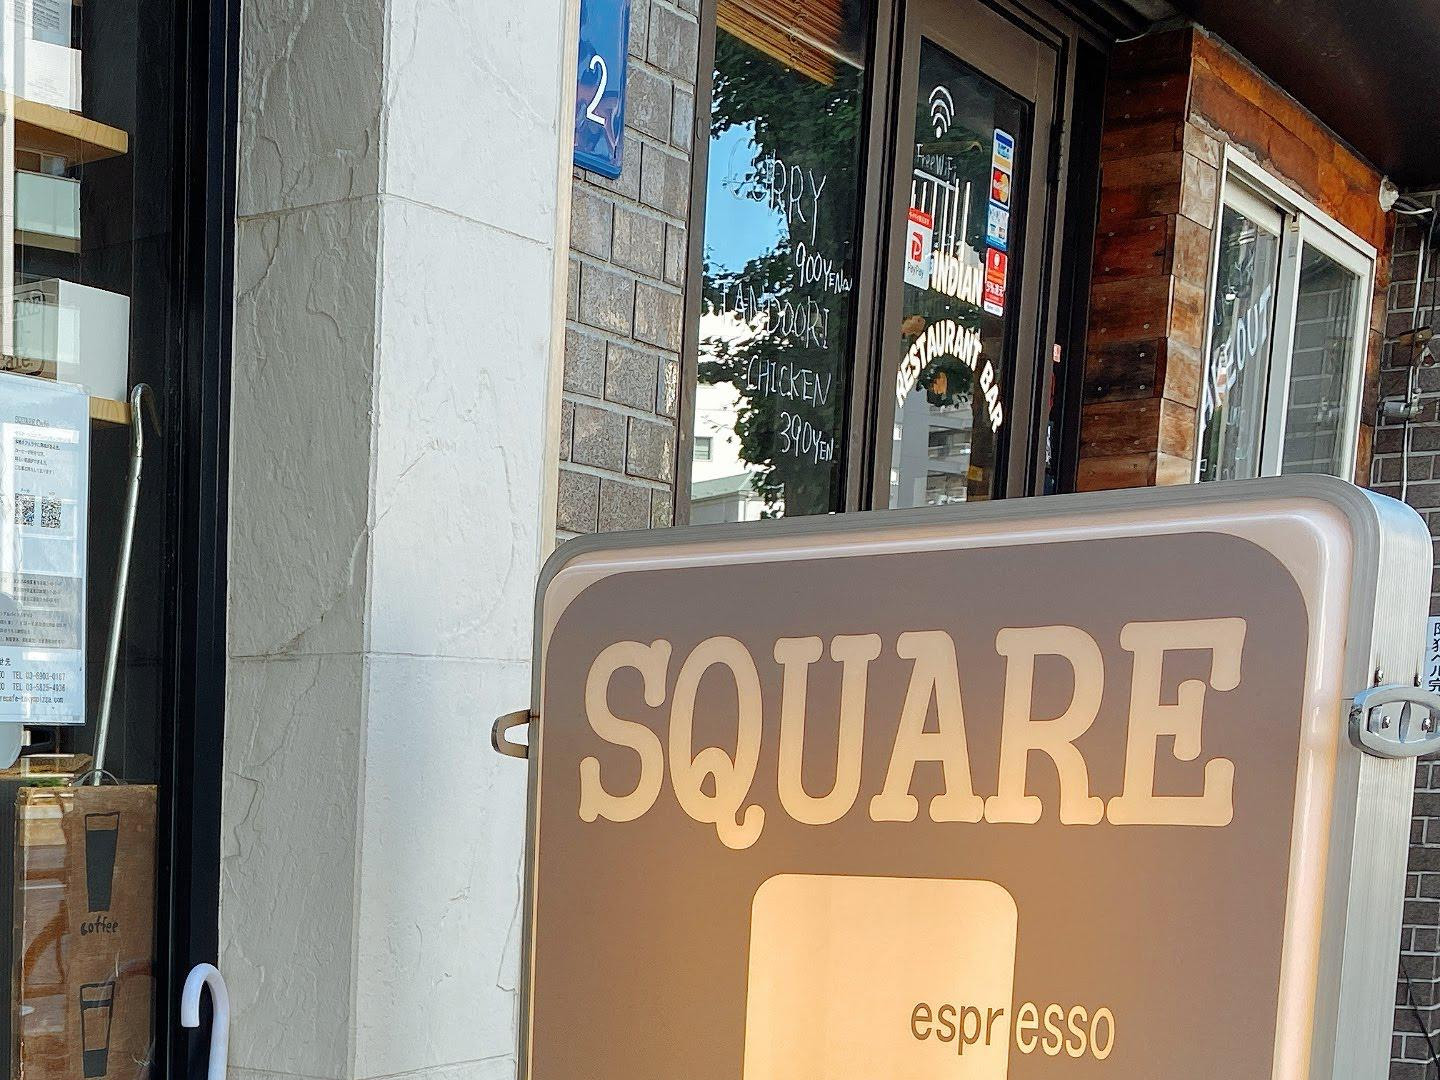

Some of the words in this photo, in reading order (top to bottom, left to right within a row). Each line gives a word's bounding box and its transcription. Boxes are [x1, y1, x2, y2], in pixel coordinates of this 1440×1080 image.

[586, 54, 609, 127] 2
[907, 261, 924, 279] PayPay
[931, 249, 984, 308] INDIAN
[746, 355, 832, 409] CHICKEN
[896, 319, 984, 409] RESTAURANT
[979, 359, 1003, 434] BAR
[578, 616, 1248, 851] SQUARE
[909, 999, 1116, 1062] espresso
